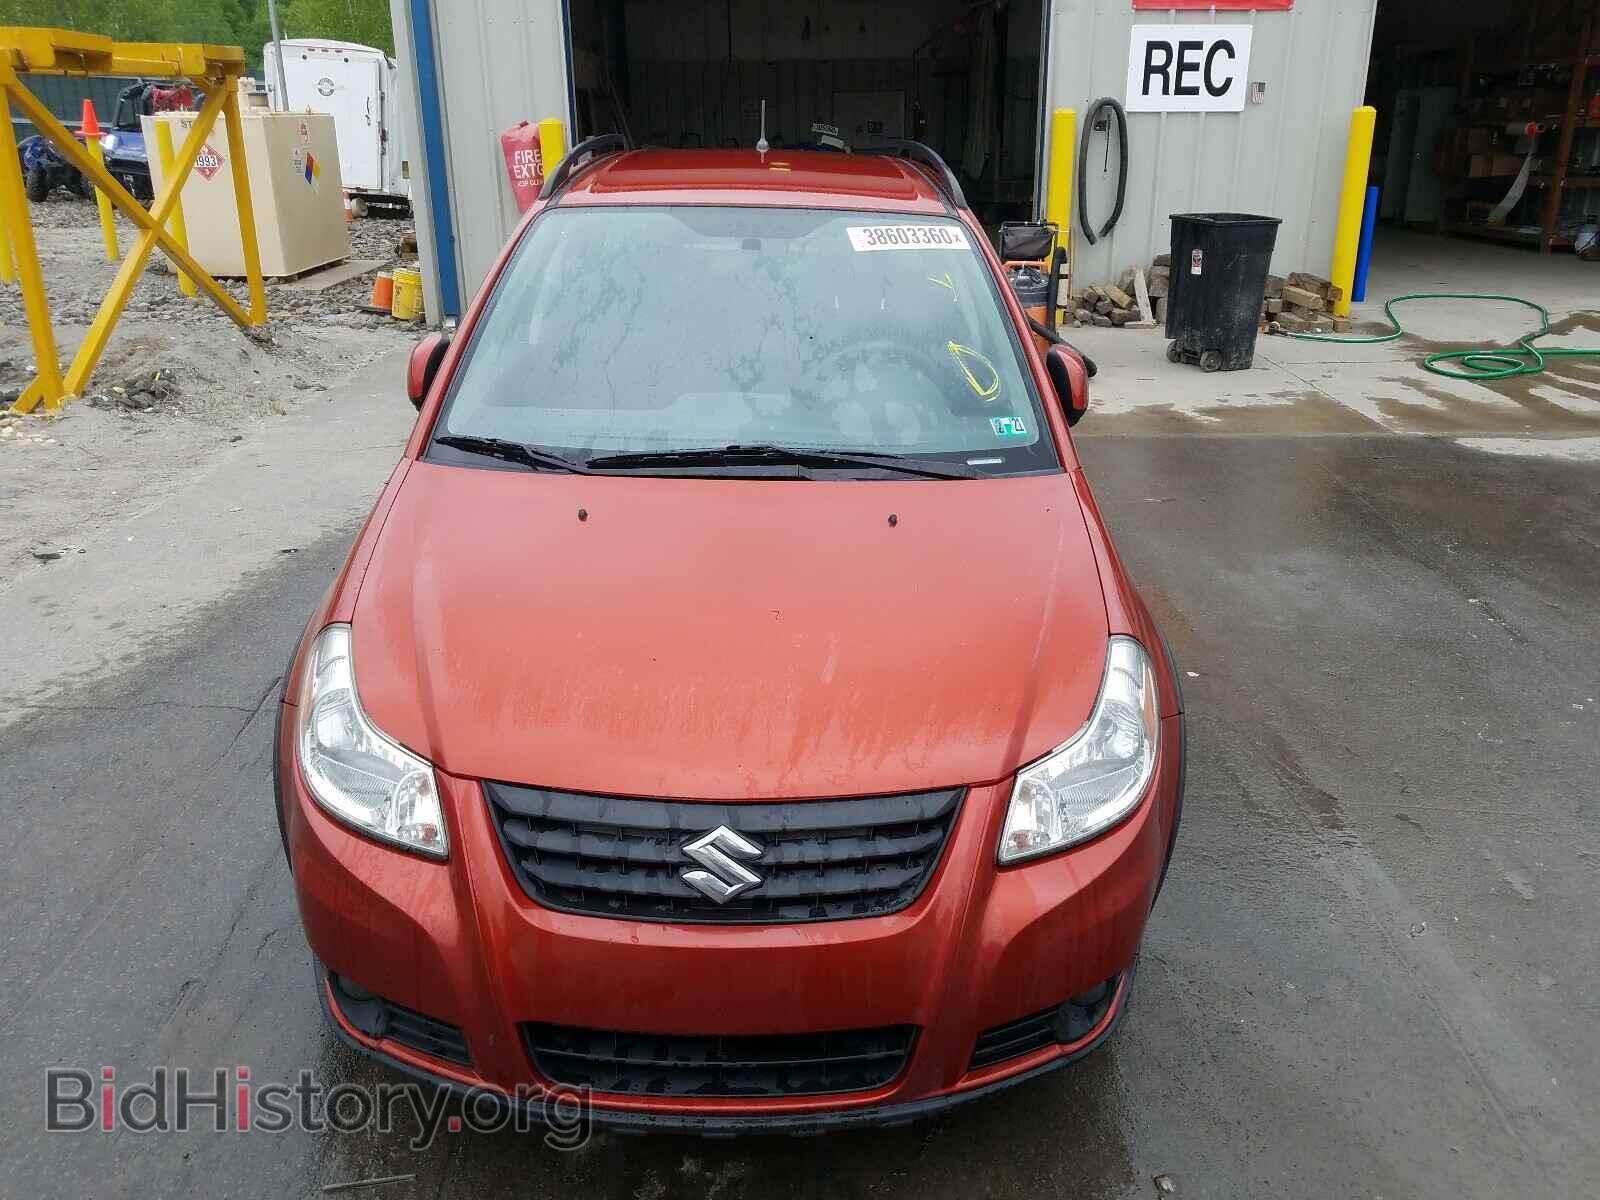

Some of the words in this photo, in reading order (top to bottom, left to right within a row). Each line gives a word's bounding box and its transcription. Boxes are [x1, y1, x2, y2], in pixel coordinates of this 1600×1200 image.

[1141, 39, 1236, 97] REC
[514, 149, 541, 165] FIRE
[863, 227, 953, 246] 38603360
